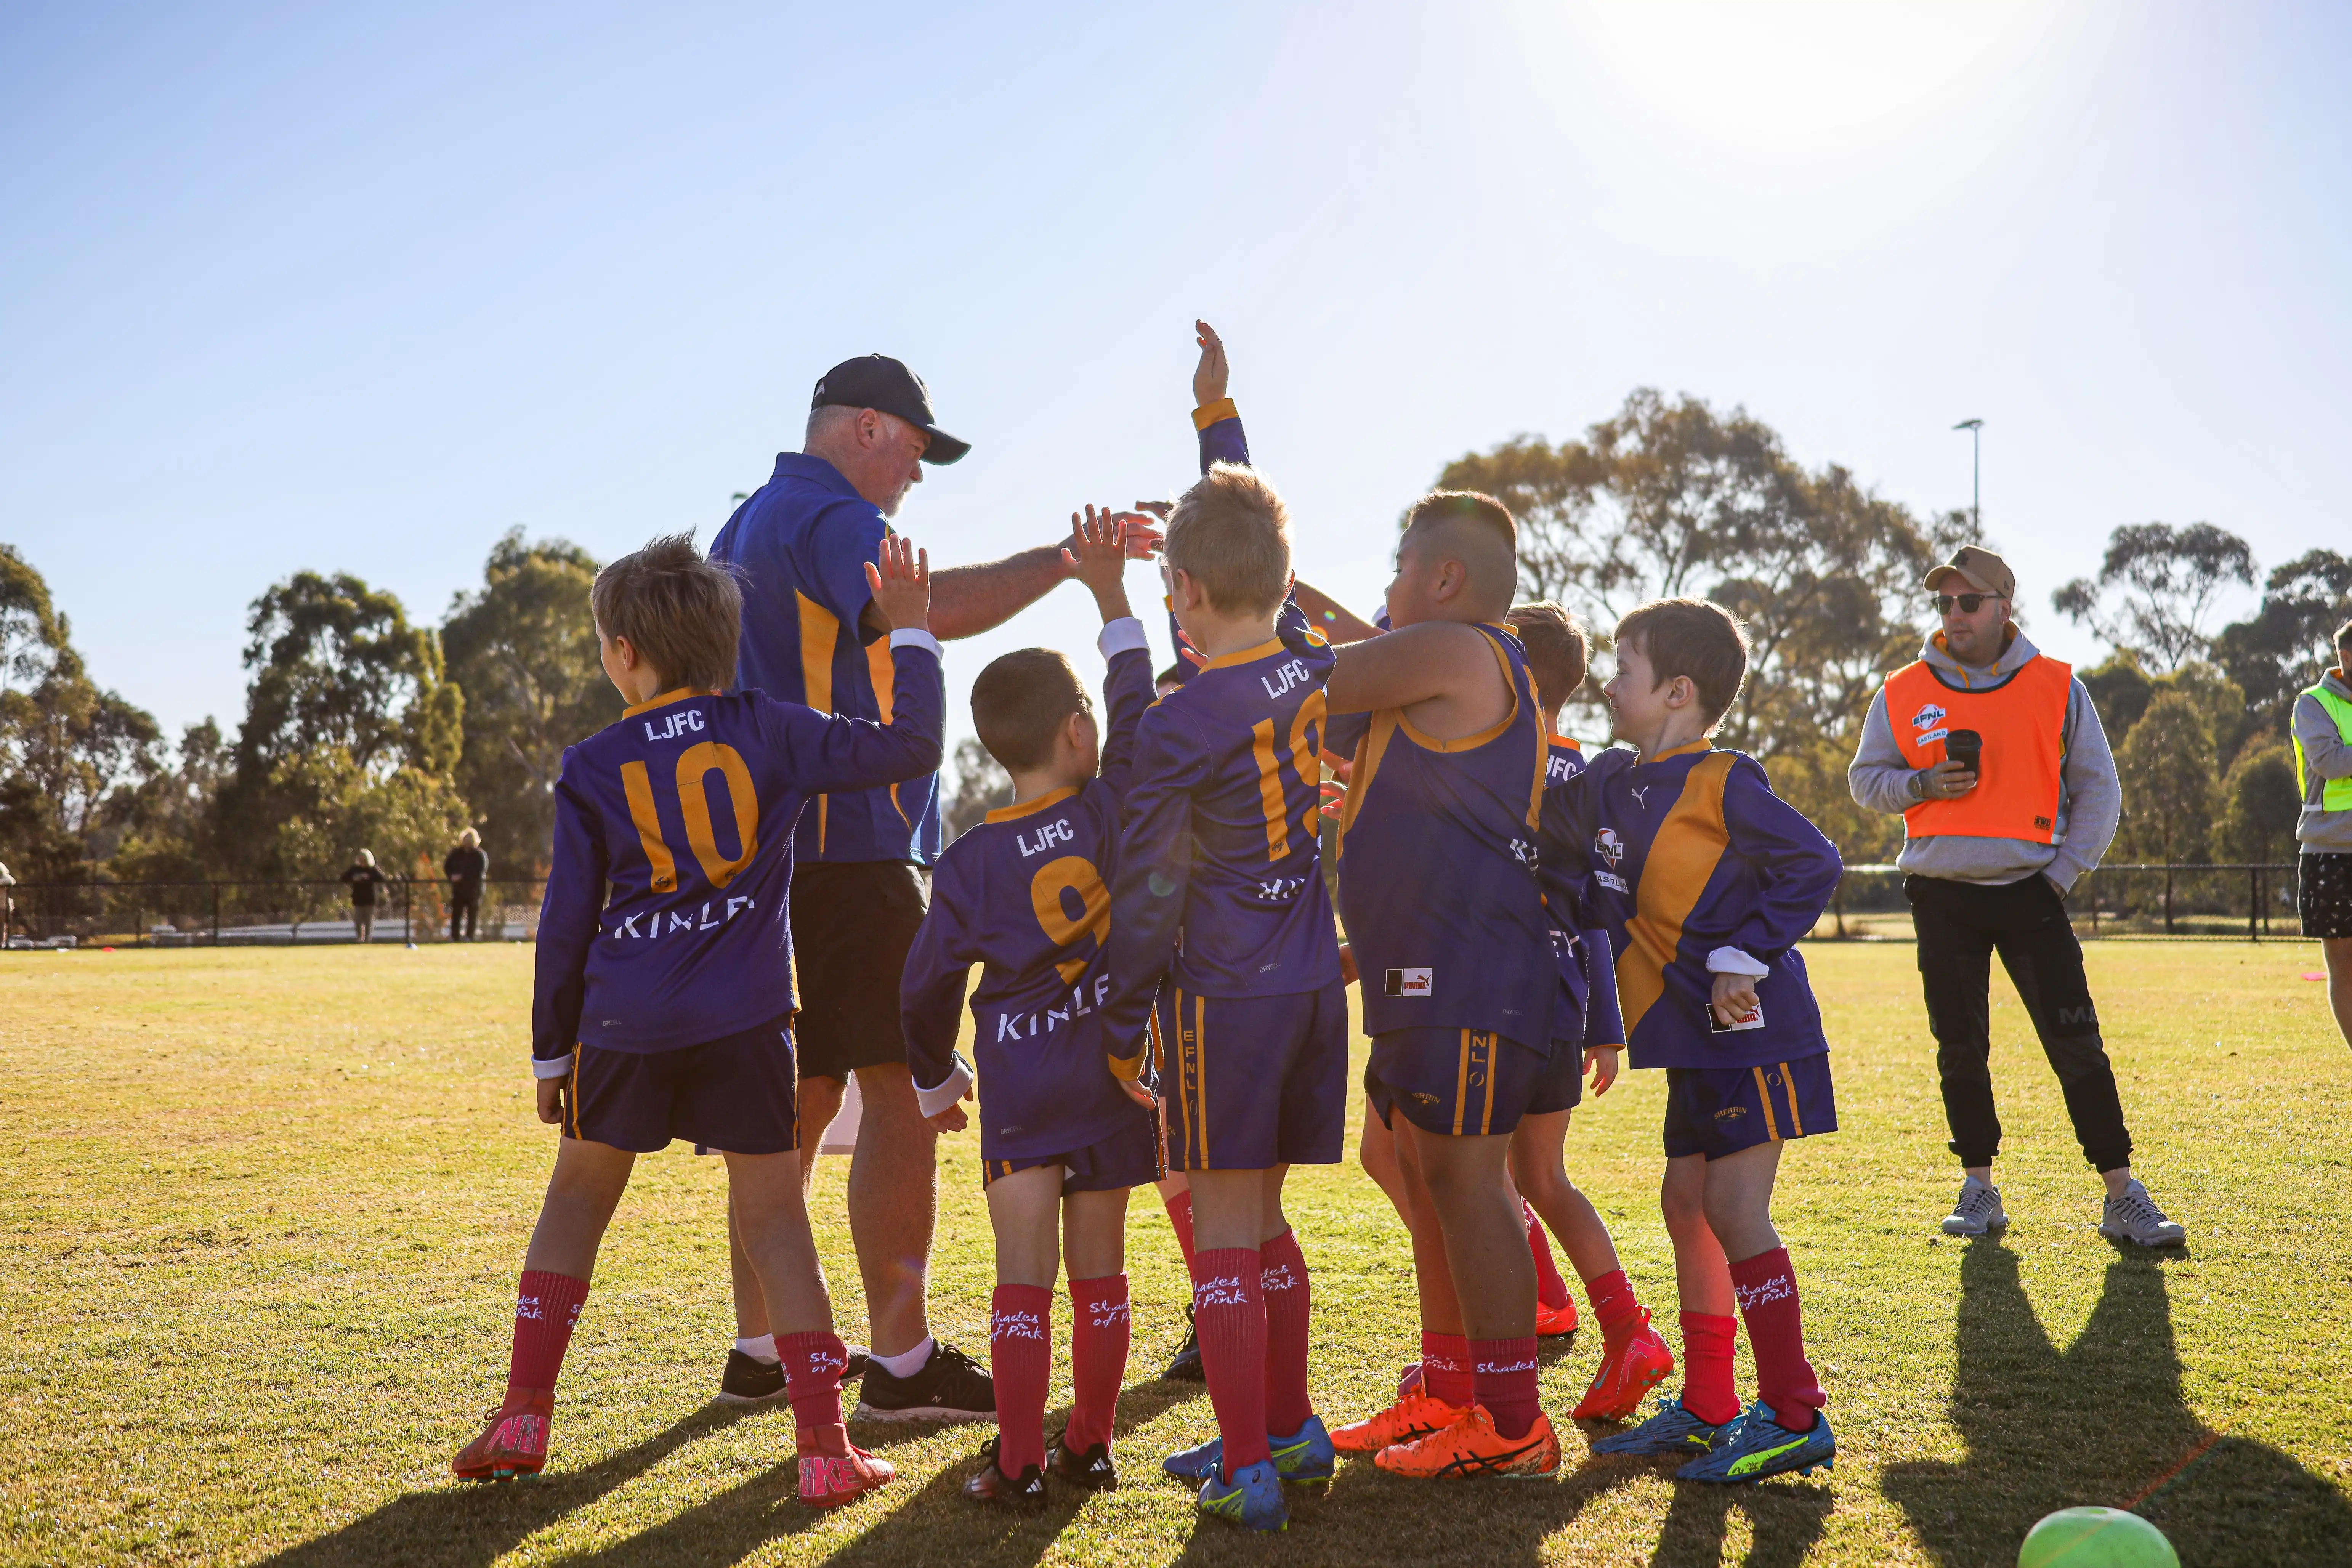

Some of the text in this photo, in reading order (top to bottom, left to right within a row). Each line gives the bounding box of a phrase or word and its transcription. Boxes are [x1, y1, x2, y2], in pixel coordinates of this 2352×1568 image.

[1260, 659, 1310, 700] LJFC
[645, 710, 704, 741] LJFC
[1913, 710, 1944, 725] EFNL
[1918, 730, 1946, 744] EASTLAND
[1546, 755, 1576, 782] JFC
[620, 741, 759, 893] 10
[1016, 819, 1074, 858] LJFC
[1596, 837, 1622, 857] ENL
[1031, 856, 1111, 985] 9
[1404, 981, 1425, 990] PUMA
[1714, 1106, 1747, 1119] SHERRIN
[1193, 1276, 1240, 1294] hades
[1735, 1274, 1786, 1297] Shades
[1761, 1283, 1793, 1306] Pink
[1204, 1288, 1248, 1309] Pink
[991, 1309, 1039, 1326] Shades
[1093, 1311, 1117, 1329] of
[1006, 1323, 1044, 1340] Pink
[1477, 1361, 1535, 1373] Shades
